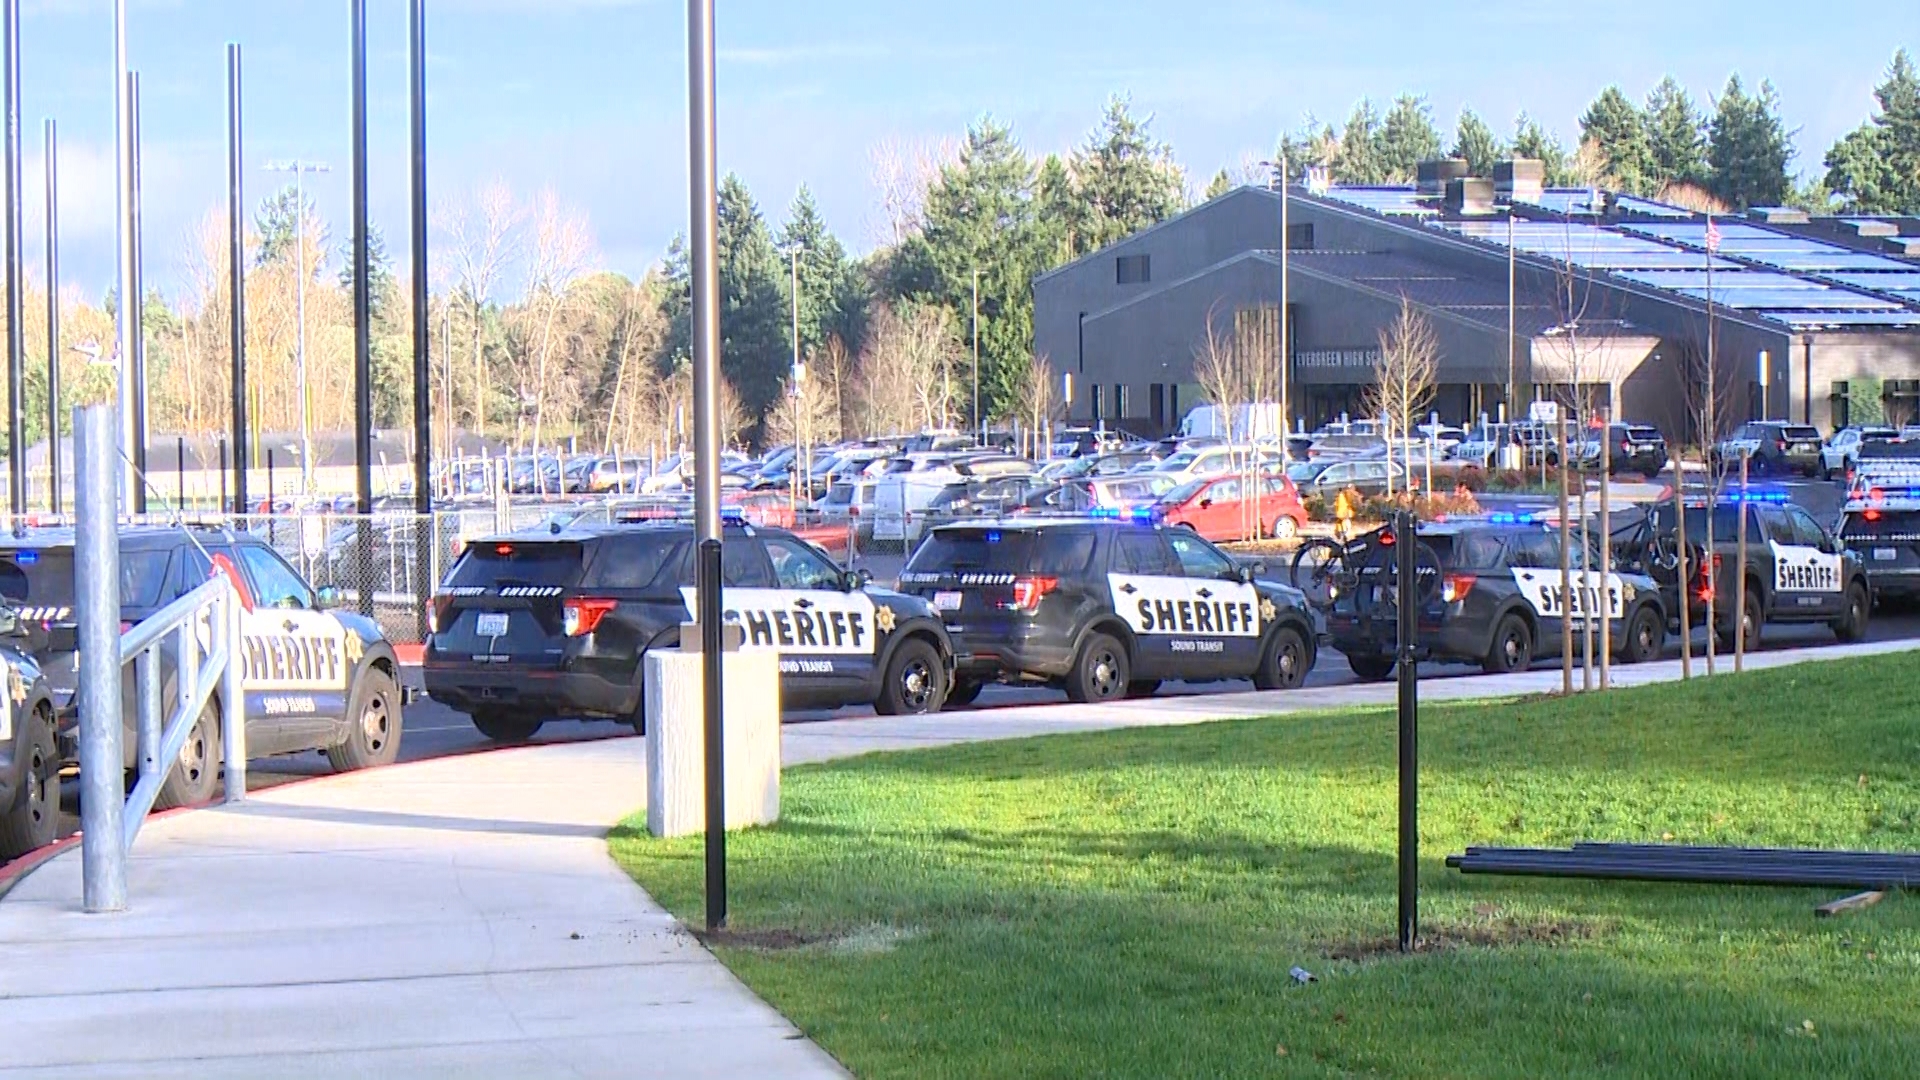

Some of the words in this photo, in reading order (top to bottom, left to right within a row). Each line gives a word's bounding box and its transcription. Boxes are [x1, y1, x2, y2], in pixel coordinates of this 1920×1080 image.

[1297, 351, 1342, 367] EVERGREEN
[1343, 351, 1364, 366] HIGH
[961, 574, 1015, 584] SHERIFF
[1779, 565, 1831, 588] SHERIFF
[499, 586, 563, 596] SHERIFF
[1138, 599, 1252, 632] SHERIFF
[1171, 640, 1195, 651] SOUND
[241, 635, 338, 680] HERIFF
